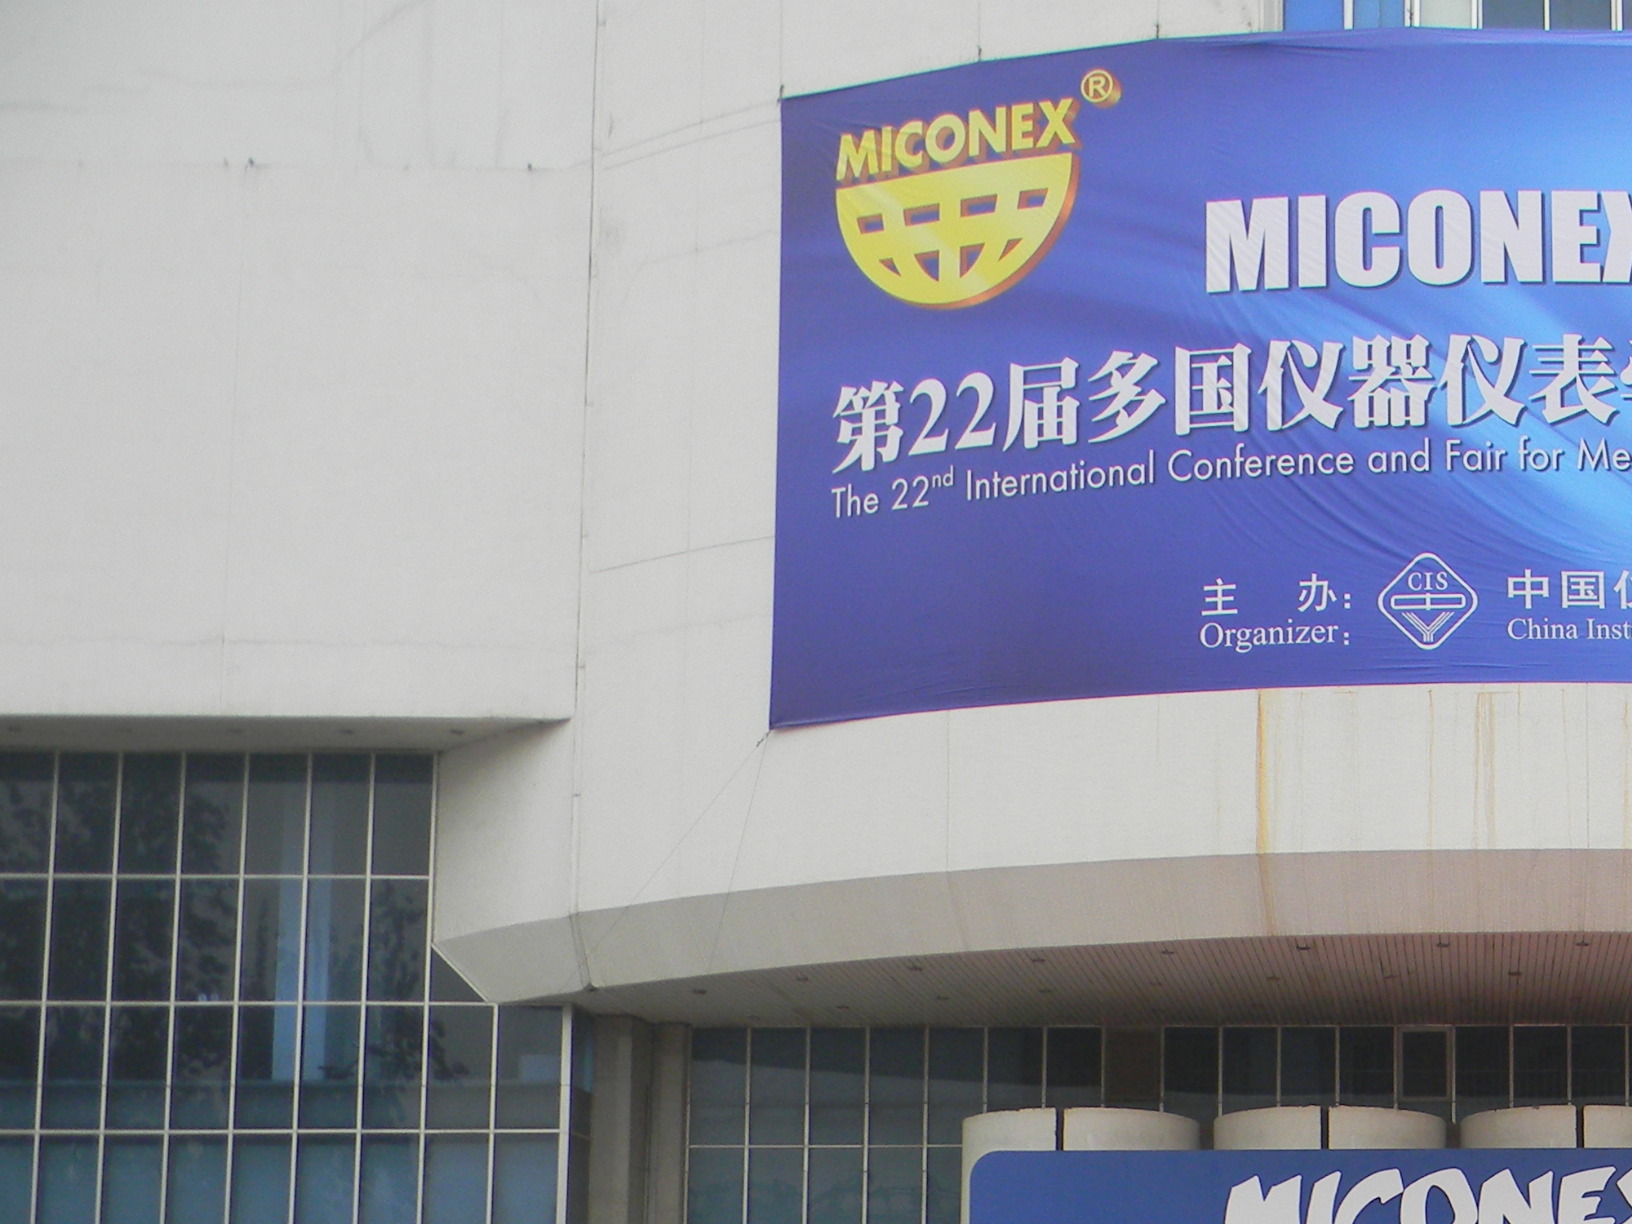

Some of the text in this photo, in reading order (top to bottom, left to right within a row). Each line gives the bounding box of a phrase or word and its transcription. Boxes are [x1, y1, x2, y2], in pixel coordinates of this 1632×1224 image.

[836, 97, 1078, 181] MICONEX
[831, 485, 880, 518] The
[966, 450, 1155, 501] International
[1167, 443, 1354, 482] Conference
[1367, 439, 1430, 474] and
[1445, 438, 1507, 472] Fair
[1518, 436, 1566, 471] for
[1407, 571, 1449, 591] CIS
[1507, 617, 1578, 641] China
